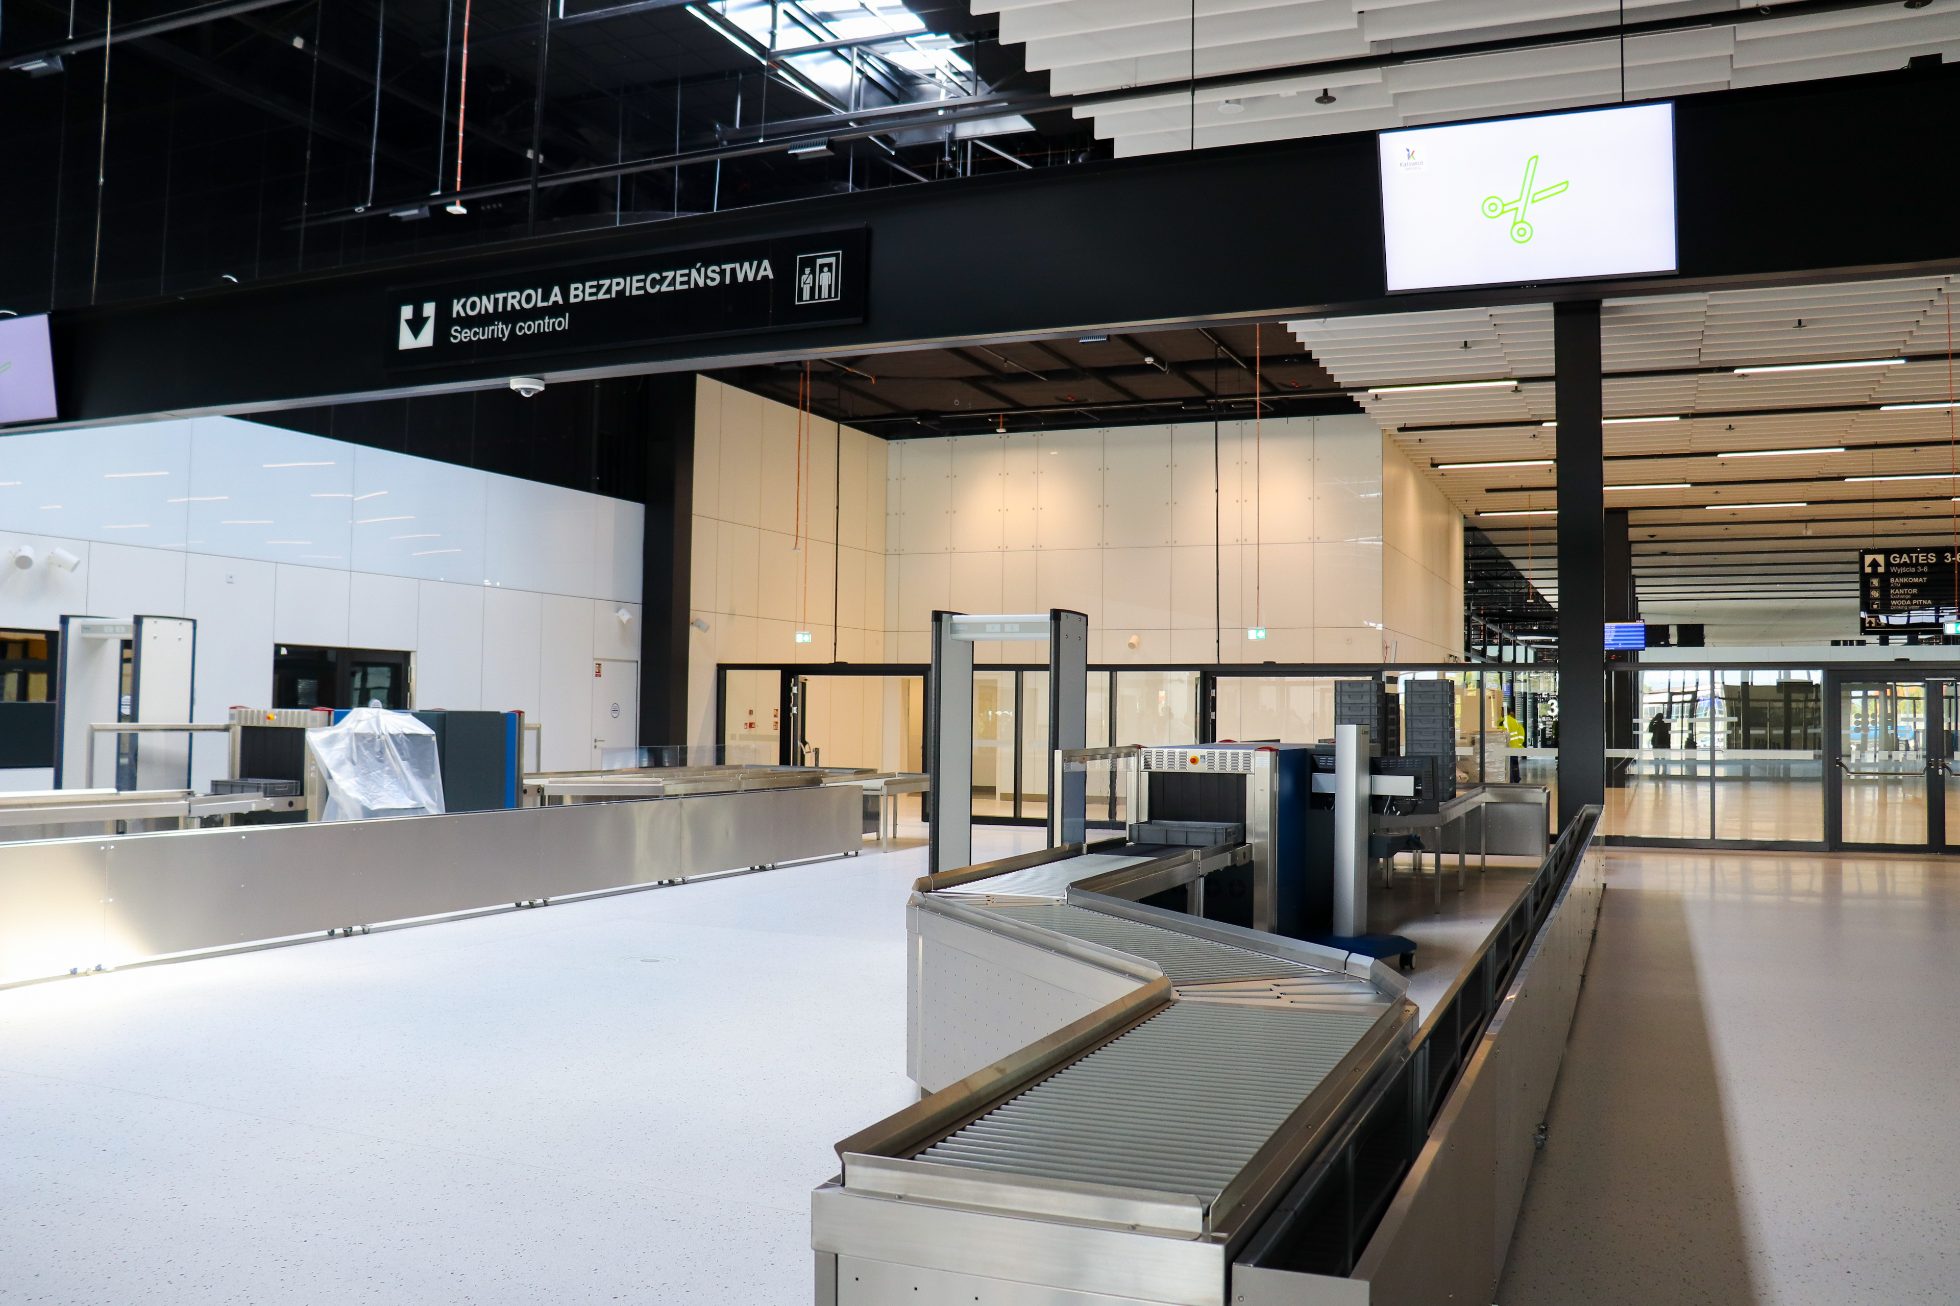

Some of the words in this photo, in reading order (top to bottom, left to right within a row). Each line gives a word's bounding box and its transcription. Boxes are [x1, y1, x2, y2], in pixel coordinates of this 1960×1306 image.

[452, 285, 564, 319] KONTROLA
[569, 258, 774, 303] BEZPIECZEŃSTWA
[450, 321, 512, 343] Security
[515, 312, 569, 336] control
[1889, 553, 1937, 564] GATES
[1890, 566, 1916, 574] Wyjścia
